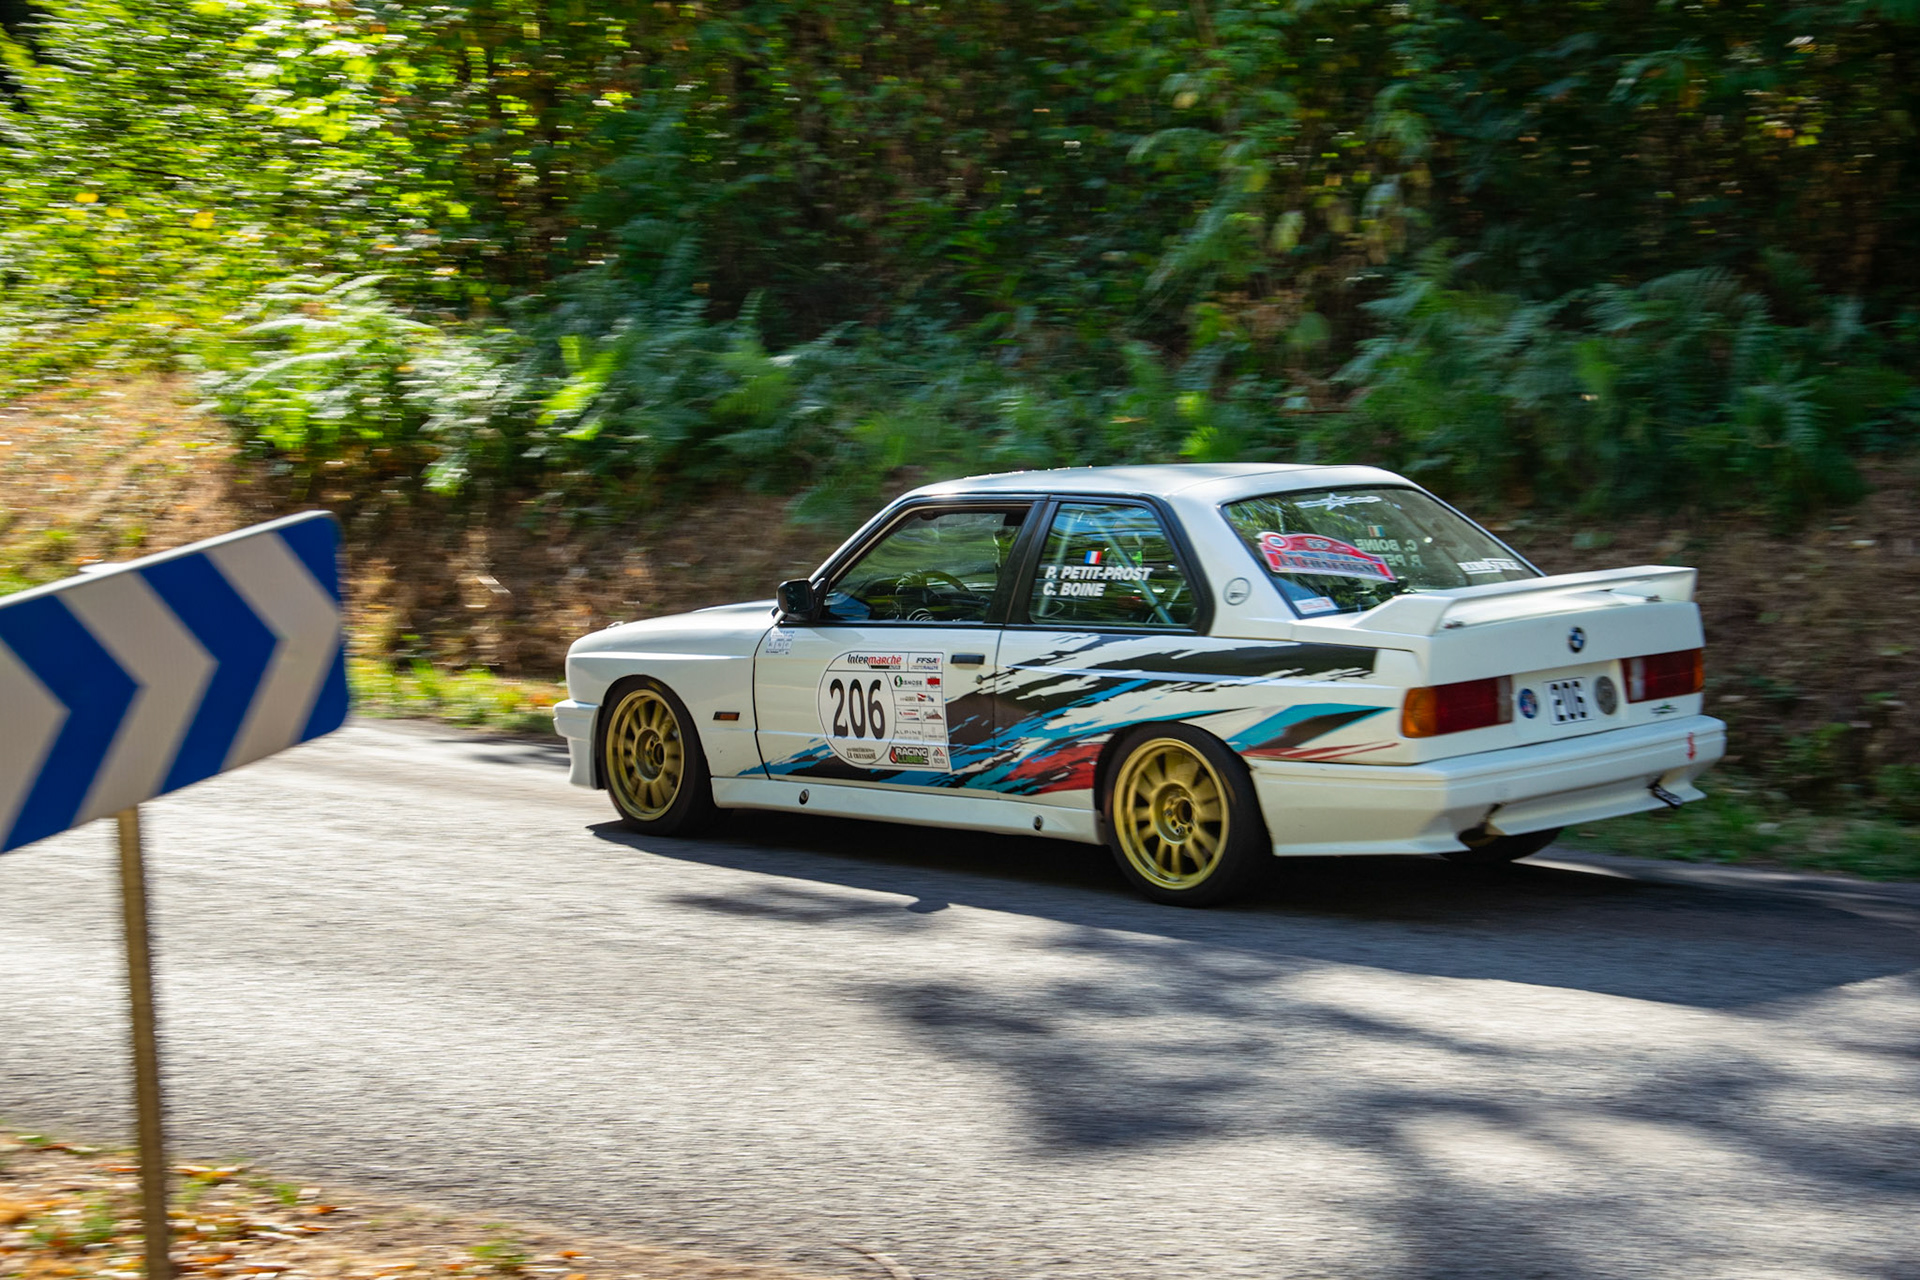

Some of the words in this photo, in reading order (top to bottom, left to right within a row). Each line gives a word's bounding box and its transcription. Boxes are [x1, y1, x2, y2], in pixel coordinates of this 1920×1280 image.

[1045, 566, 1057, 579] P.
[1060, 566, 1154, 580] PETIT-PROST
[1042, 582, 1057, 596] C.
[1060, 582, 1106, 596] BOINE
[1550, 680, 1588, 722] 206
[829, 678, 886, 740] 206
[895, 747, 928, 756] RACING
